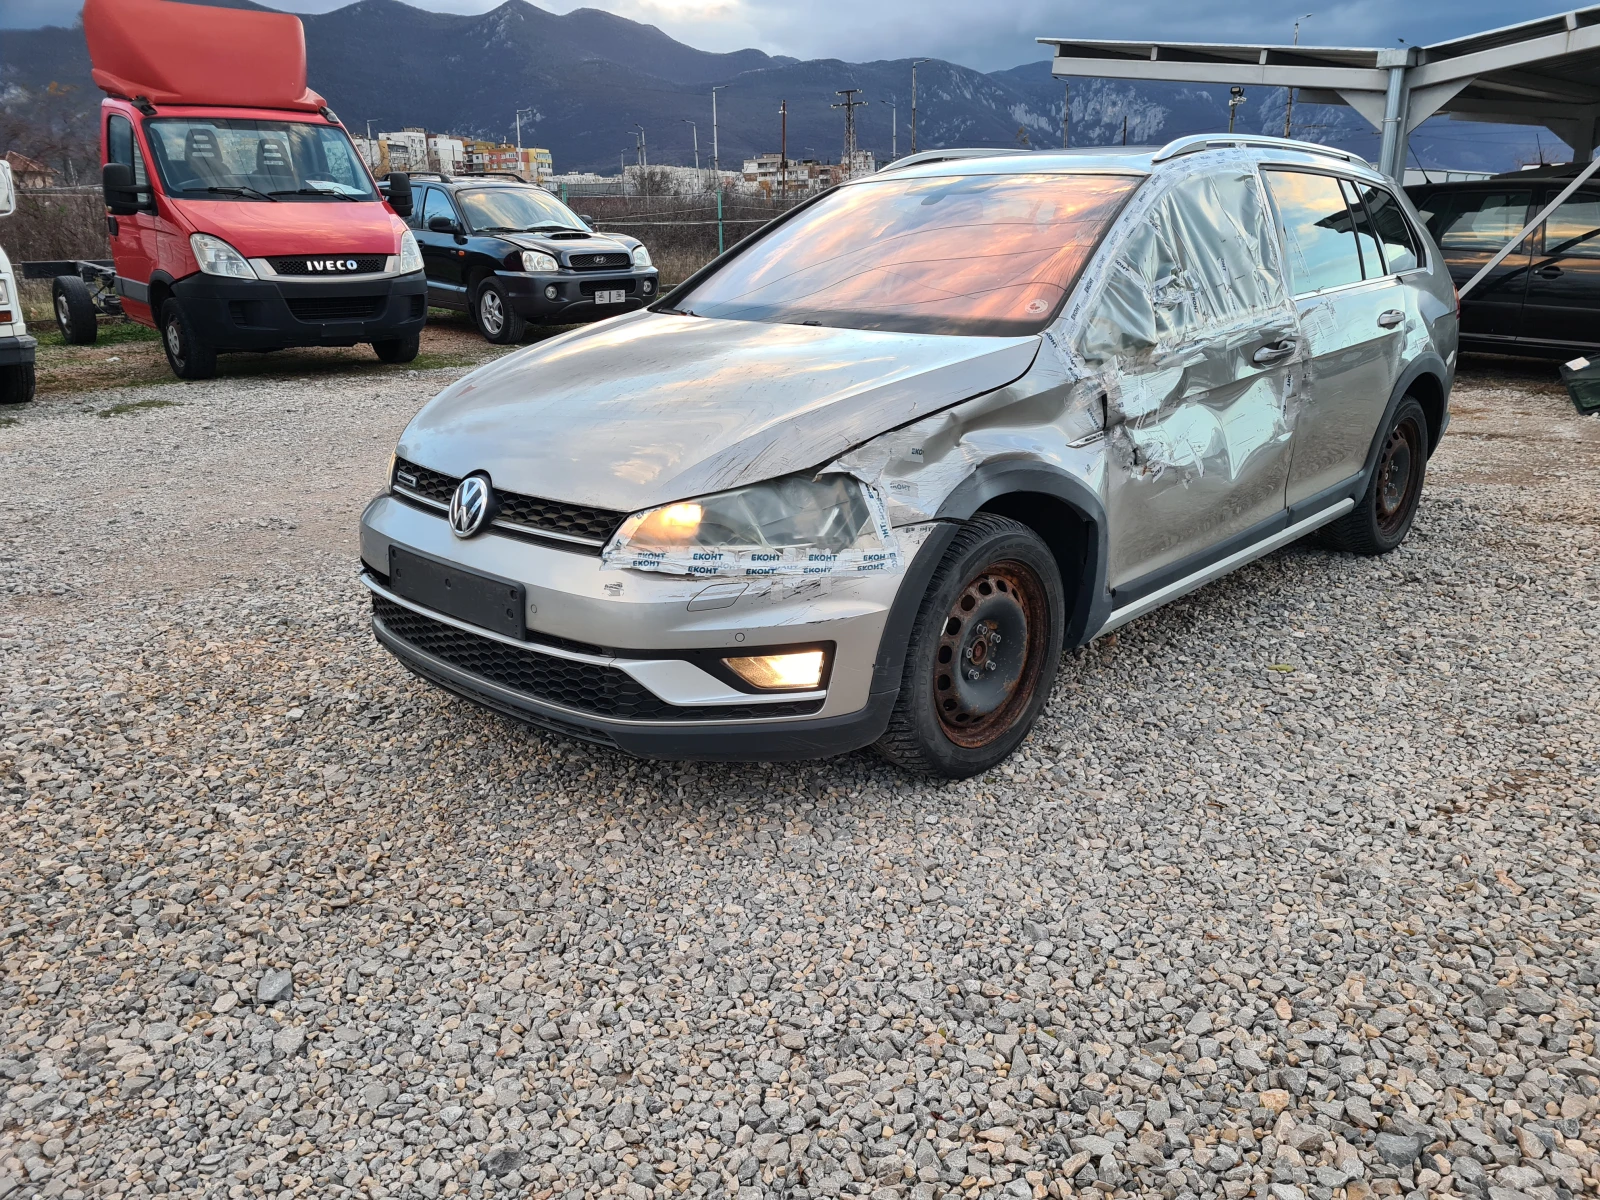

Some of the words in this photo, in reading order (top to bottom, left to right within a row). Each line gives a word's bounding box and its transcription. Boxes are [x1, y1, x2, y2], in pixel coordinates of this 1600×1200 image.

[306, 260, 358, 271] IVECO
[692, 553, 723, 561] ЕКОНТ
[808, 553, 838, 562] ЕКОНТ
[863, 553, 886, 561] ЕКОН
[688, 565, 719, 574] ЕКОНТ
[803, 566, 833, 574] ЕКОНТ
[857, 562, 885, 571] ЕКОНТ
